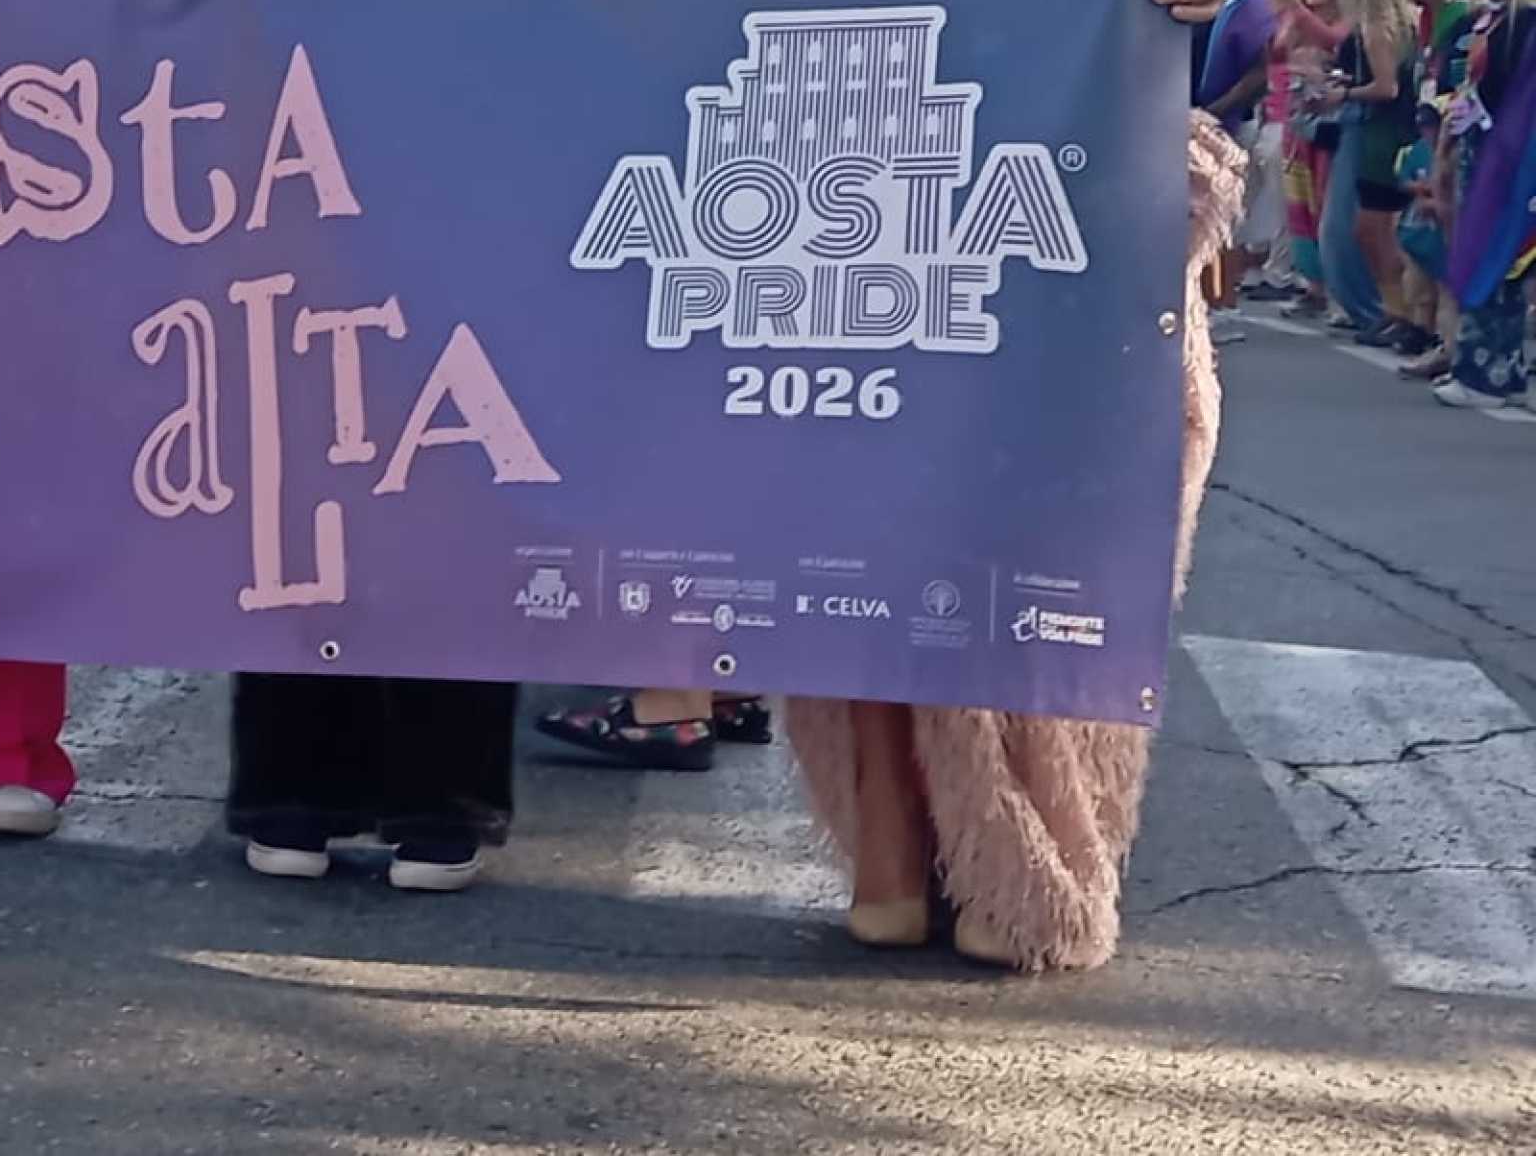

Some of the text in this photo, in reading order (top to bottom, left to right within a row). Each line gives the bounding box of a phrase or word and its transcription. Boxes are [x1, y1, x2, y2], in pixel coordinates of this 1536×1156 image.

[647, 262, 999, 353] PRIDE
[724, 366, 902, 420] 2026
[823, 596, 891, 619] CELVA
